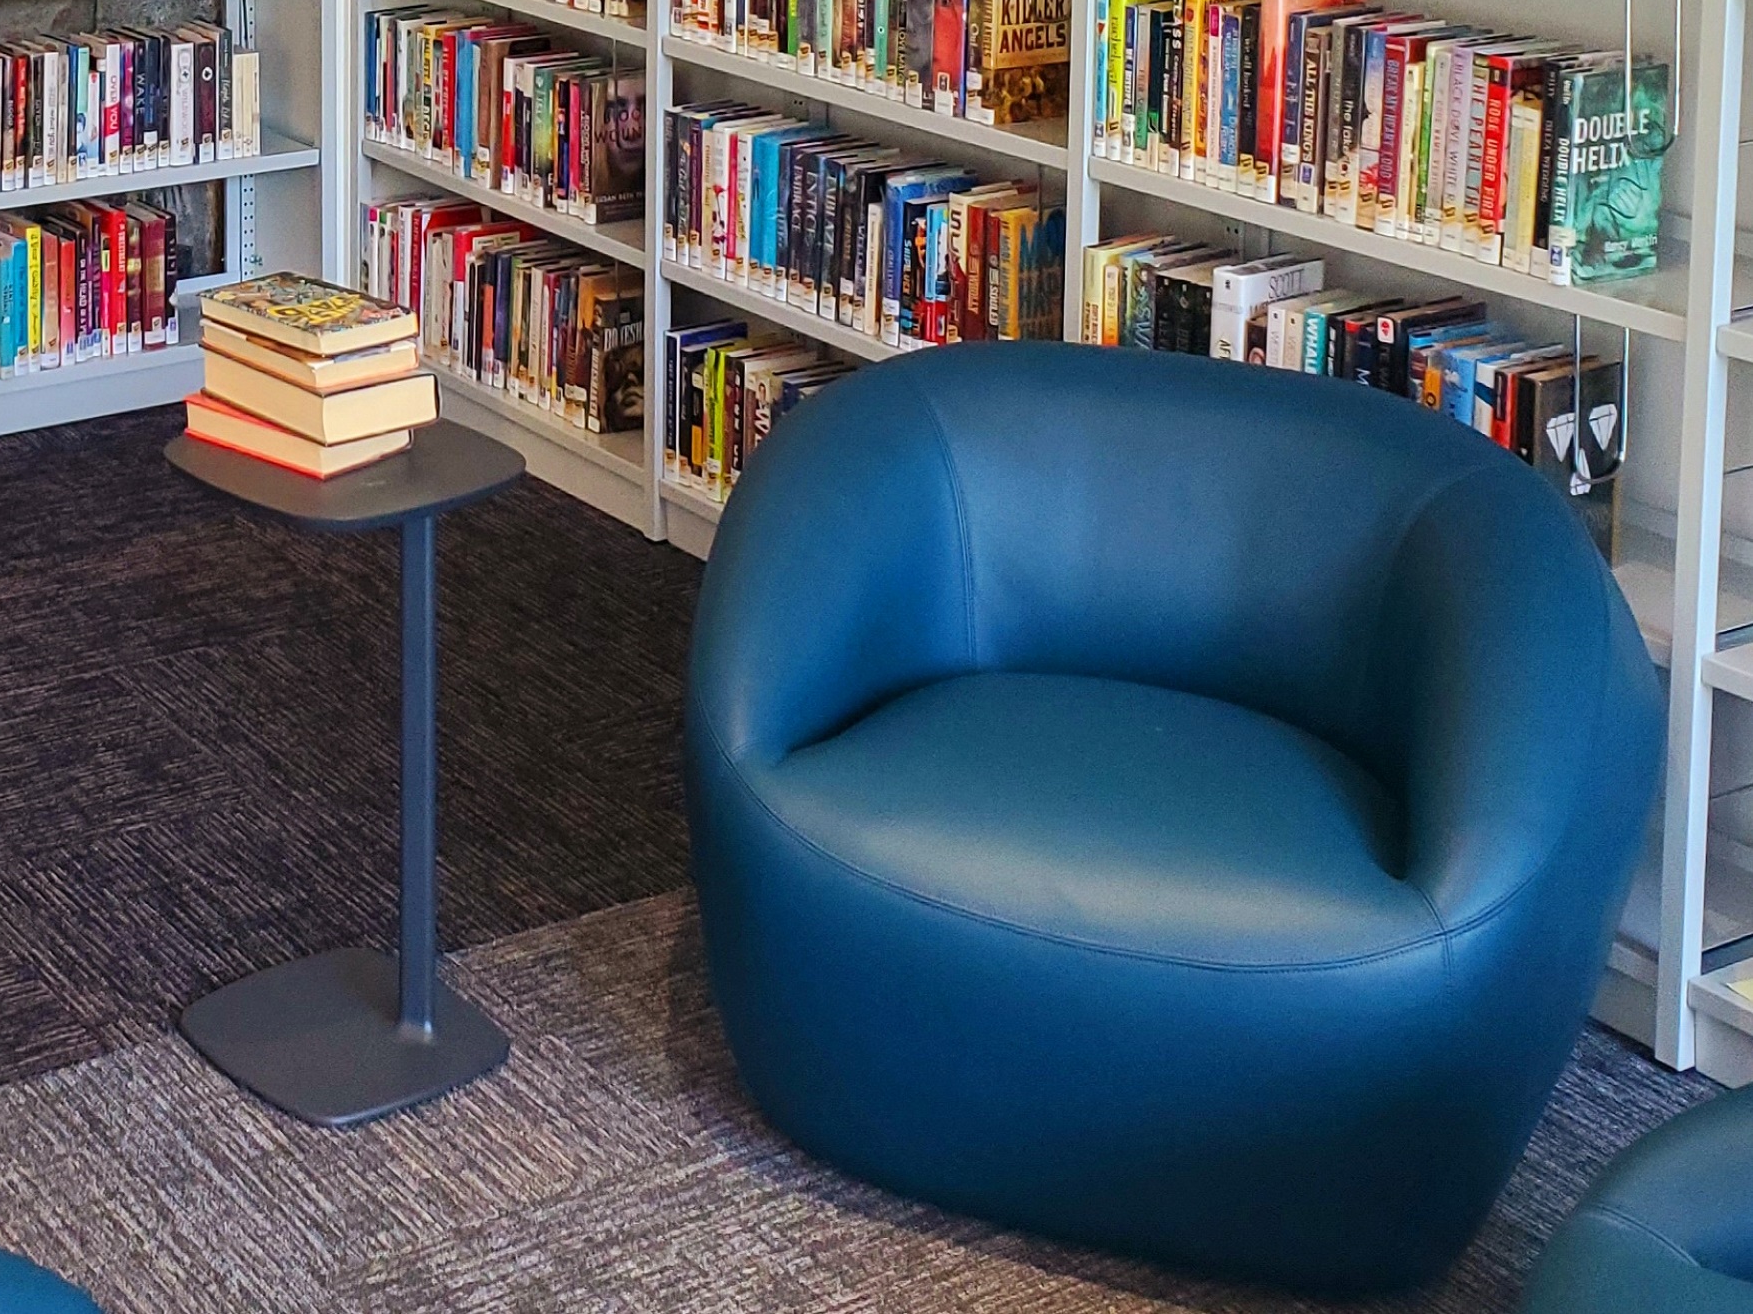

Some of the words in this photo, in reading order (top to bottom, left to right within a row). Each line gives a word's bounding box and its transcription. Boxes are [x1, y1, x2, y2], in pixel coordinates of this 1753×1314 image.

[999, 23, 1066, 54] ANGELS
[109, 74, 117, 103] OVER
[136, 72, 146, 114] WAKE
[109, 107, 118, 130] YOU
[1487, 98, 1502, 130] ROSE
[1574, 108, 1651, 144] DOUBLE
[1484, 134, 1499, 180] UNDER
[1572, 143, 1631, 174] HELIX
[1481, 184, 1495, 218] FIRE
